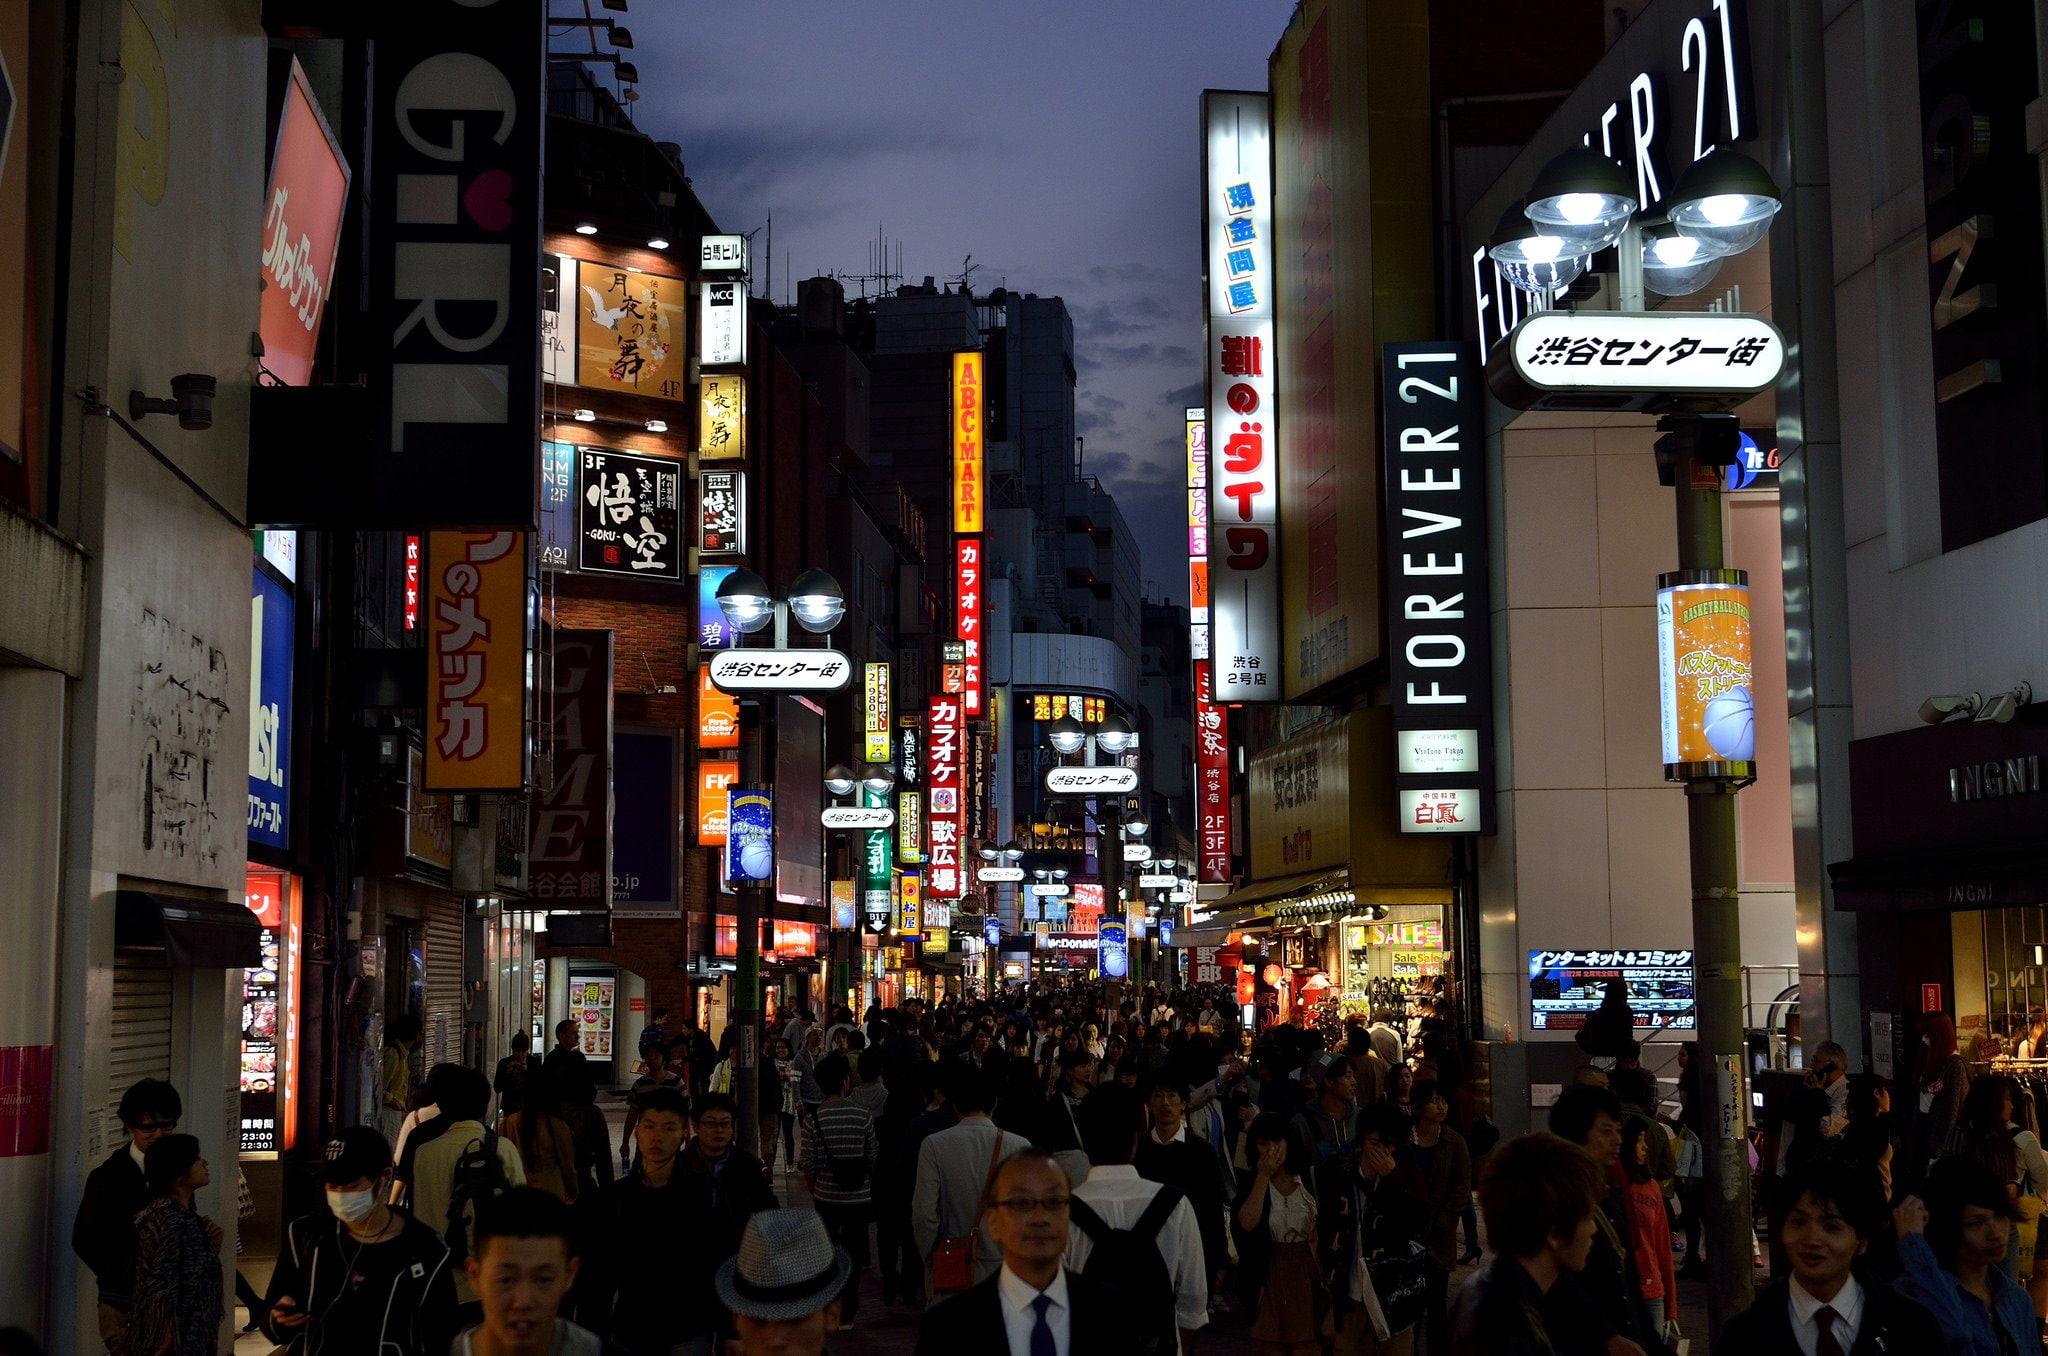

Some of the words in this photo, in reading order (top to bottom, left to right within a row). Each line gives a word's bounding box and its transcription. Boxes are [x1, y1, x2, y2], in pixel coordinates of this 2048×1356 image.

[1682, 0, 1740, 162] 21
[703, 244, 740, 261] 白馬ビル
[710, 290, 734, 300] MCC
[1528, 336, 1771, 367] 渋谷センター街
[1397, 352, 1459, 404] 21
[659, 380, 681, 398] 4F
[959, 363, 976, 522] ABC-MART
[585, 455, 606, 470] 3F
[550, 488, 568, 501] 2F
[586, 471, 669, 570] 悟空
[543, 546, 568, 559] AOI
[1399, 424, 1468, 705] FOREVER
[702, 569, 716, 580] 2F
[407, 542, 418, 630] カラオケ
[1683, 600, 1732, 625] BASKETBALL
[701, 620, 723, 648] 碧
[717, 662, 843, 678] 渋谷センター街
[1233, 656, 1261, 669] 渋谷
[1228, 672, 1267, 686] 2号店
[930, 701, 958, 783] カラオケ
[705, 773, 733, 789] FK
[1050, 775, 1132, 786] 渋谷センター街
[1207, 768, 1220, 804] 渋谷店
[1949, 754, 2040, 803] INGNI
[1422, 792, 1457, 800] 中国料理
[824, 812, 890, 823] 渋谷センター街
[1204, 815, 1225, 829] 2F
[1205, 836, 1226, 850] 3F
[930, 820, 958, 892] 歌広場
[1206, 858, 1226, 871] 4F
[869, 913, 891, 922] B1F
[903, 900, 918, 929] 松屋
[1373, 923, 1425, 947] SALE
[1394, 953, 1417, 964] Sale
[1531, 950, 1693, 968] インターネット&コミック
[1394, 965, 1418, 976] Sale
[584, 984, 601, 1004] 得
